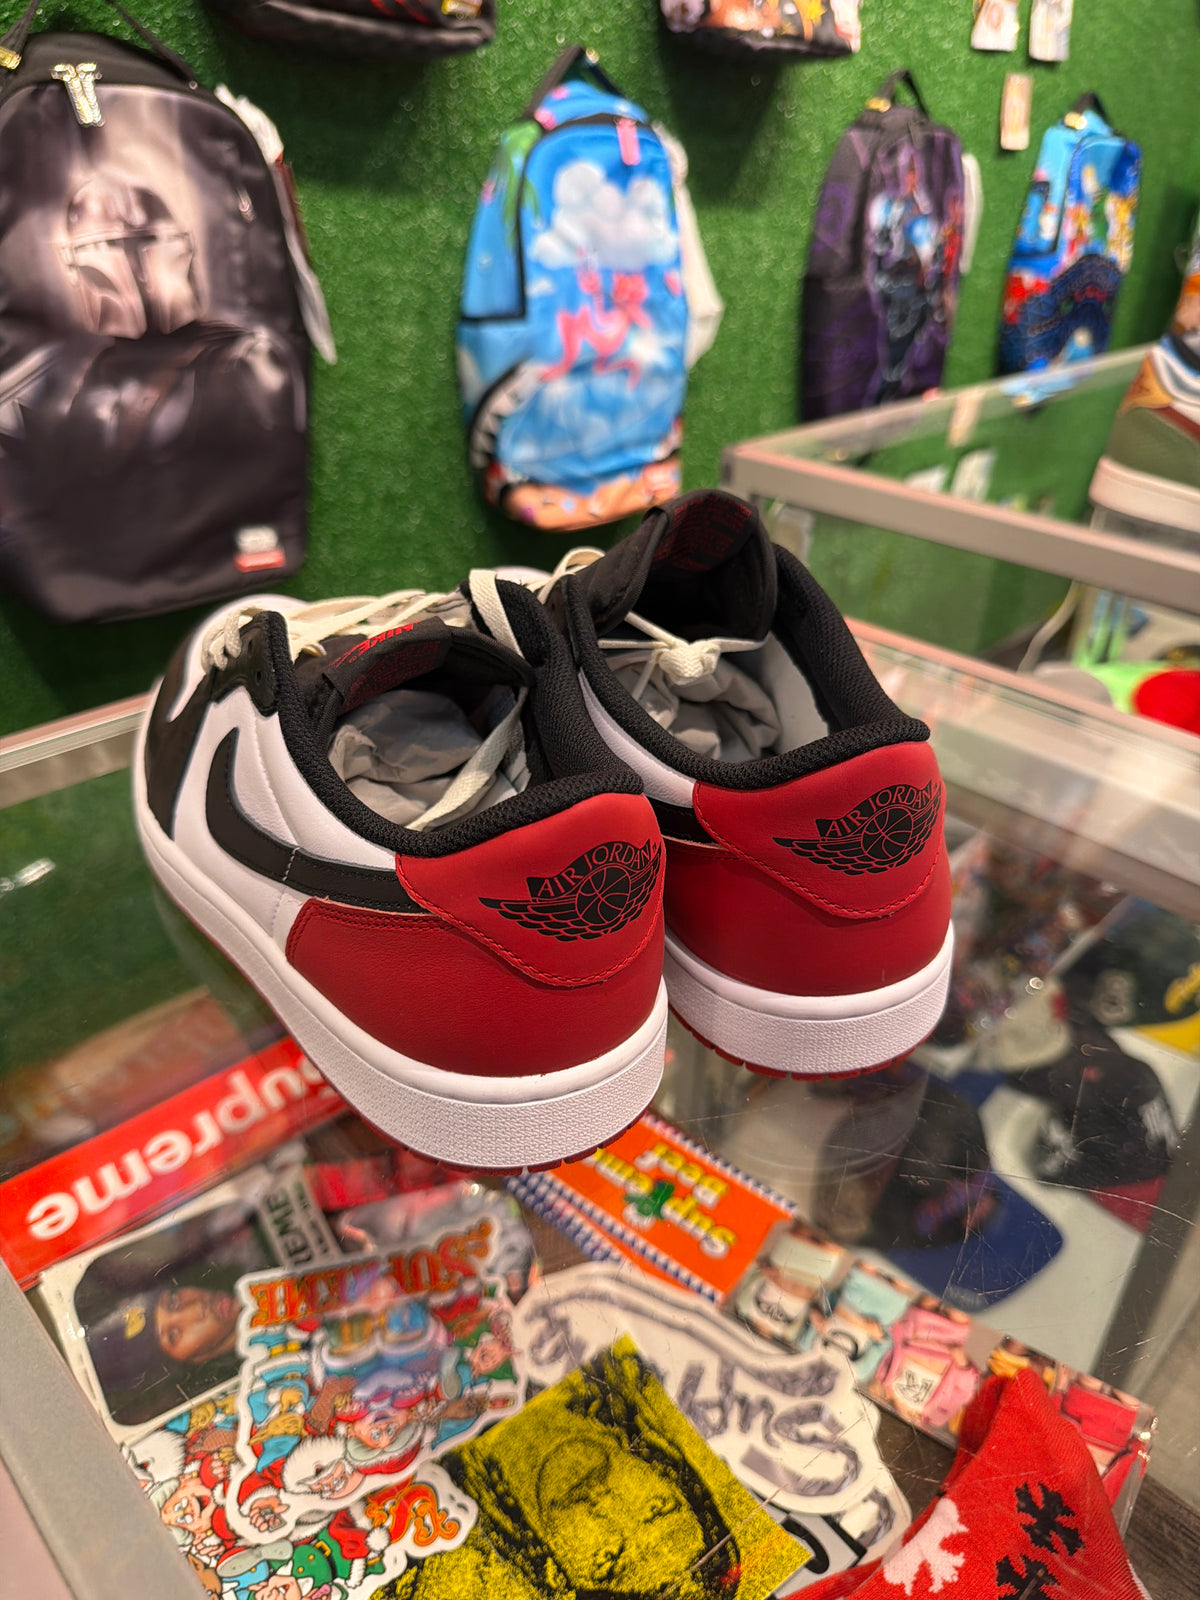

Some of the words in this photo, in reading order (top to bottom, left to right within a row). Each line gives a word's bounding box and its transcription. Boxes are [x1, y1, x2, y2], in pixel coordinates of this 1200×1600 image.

[358, 622, 414, 656] NIKE
[825, 808, 869, 837] AIR
[868, 785, 932, 813] JORDAN
[537, 867, 584, 897] AIR
[584, 842, 651, 871] JORDAN
[634, 1142, 728, 1209] Beef
